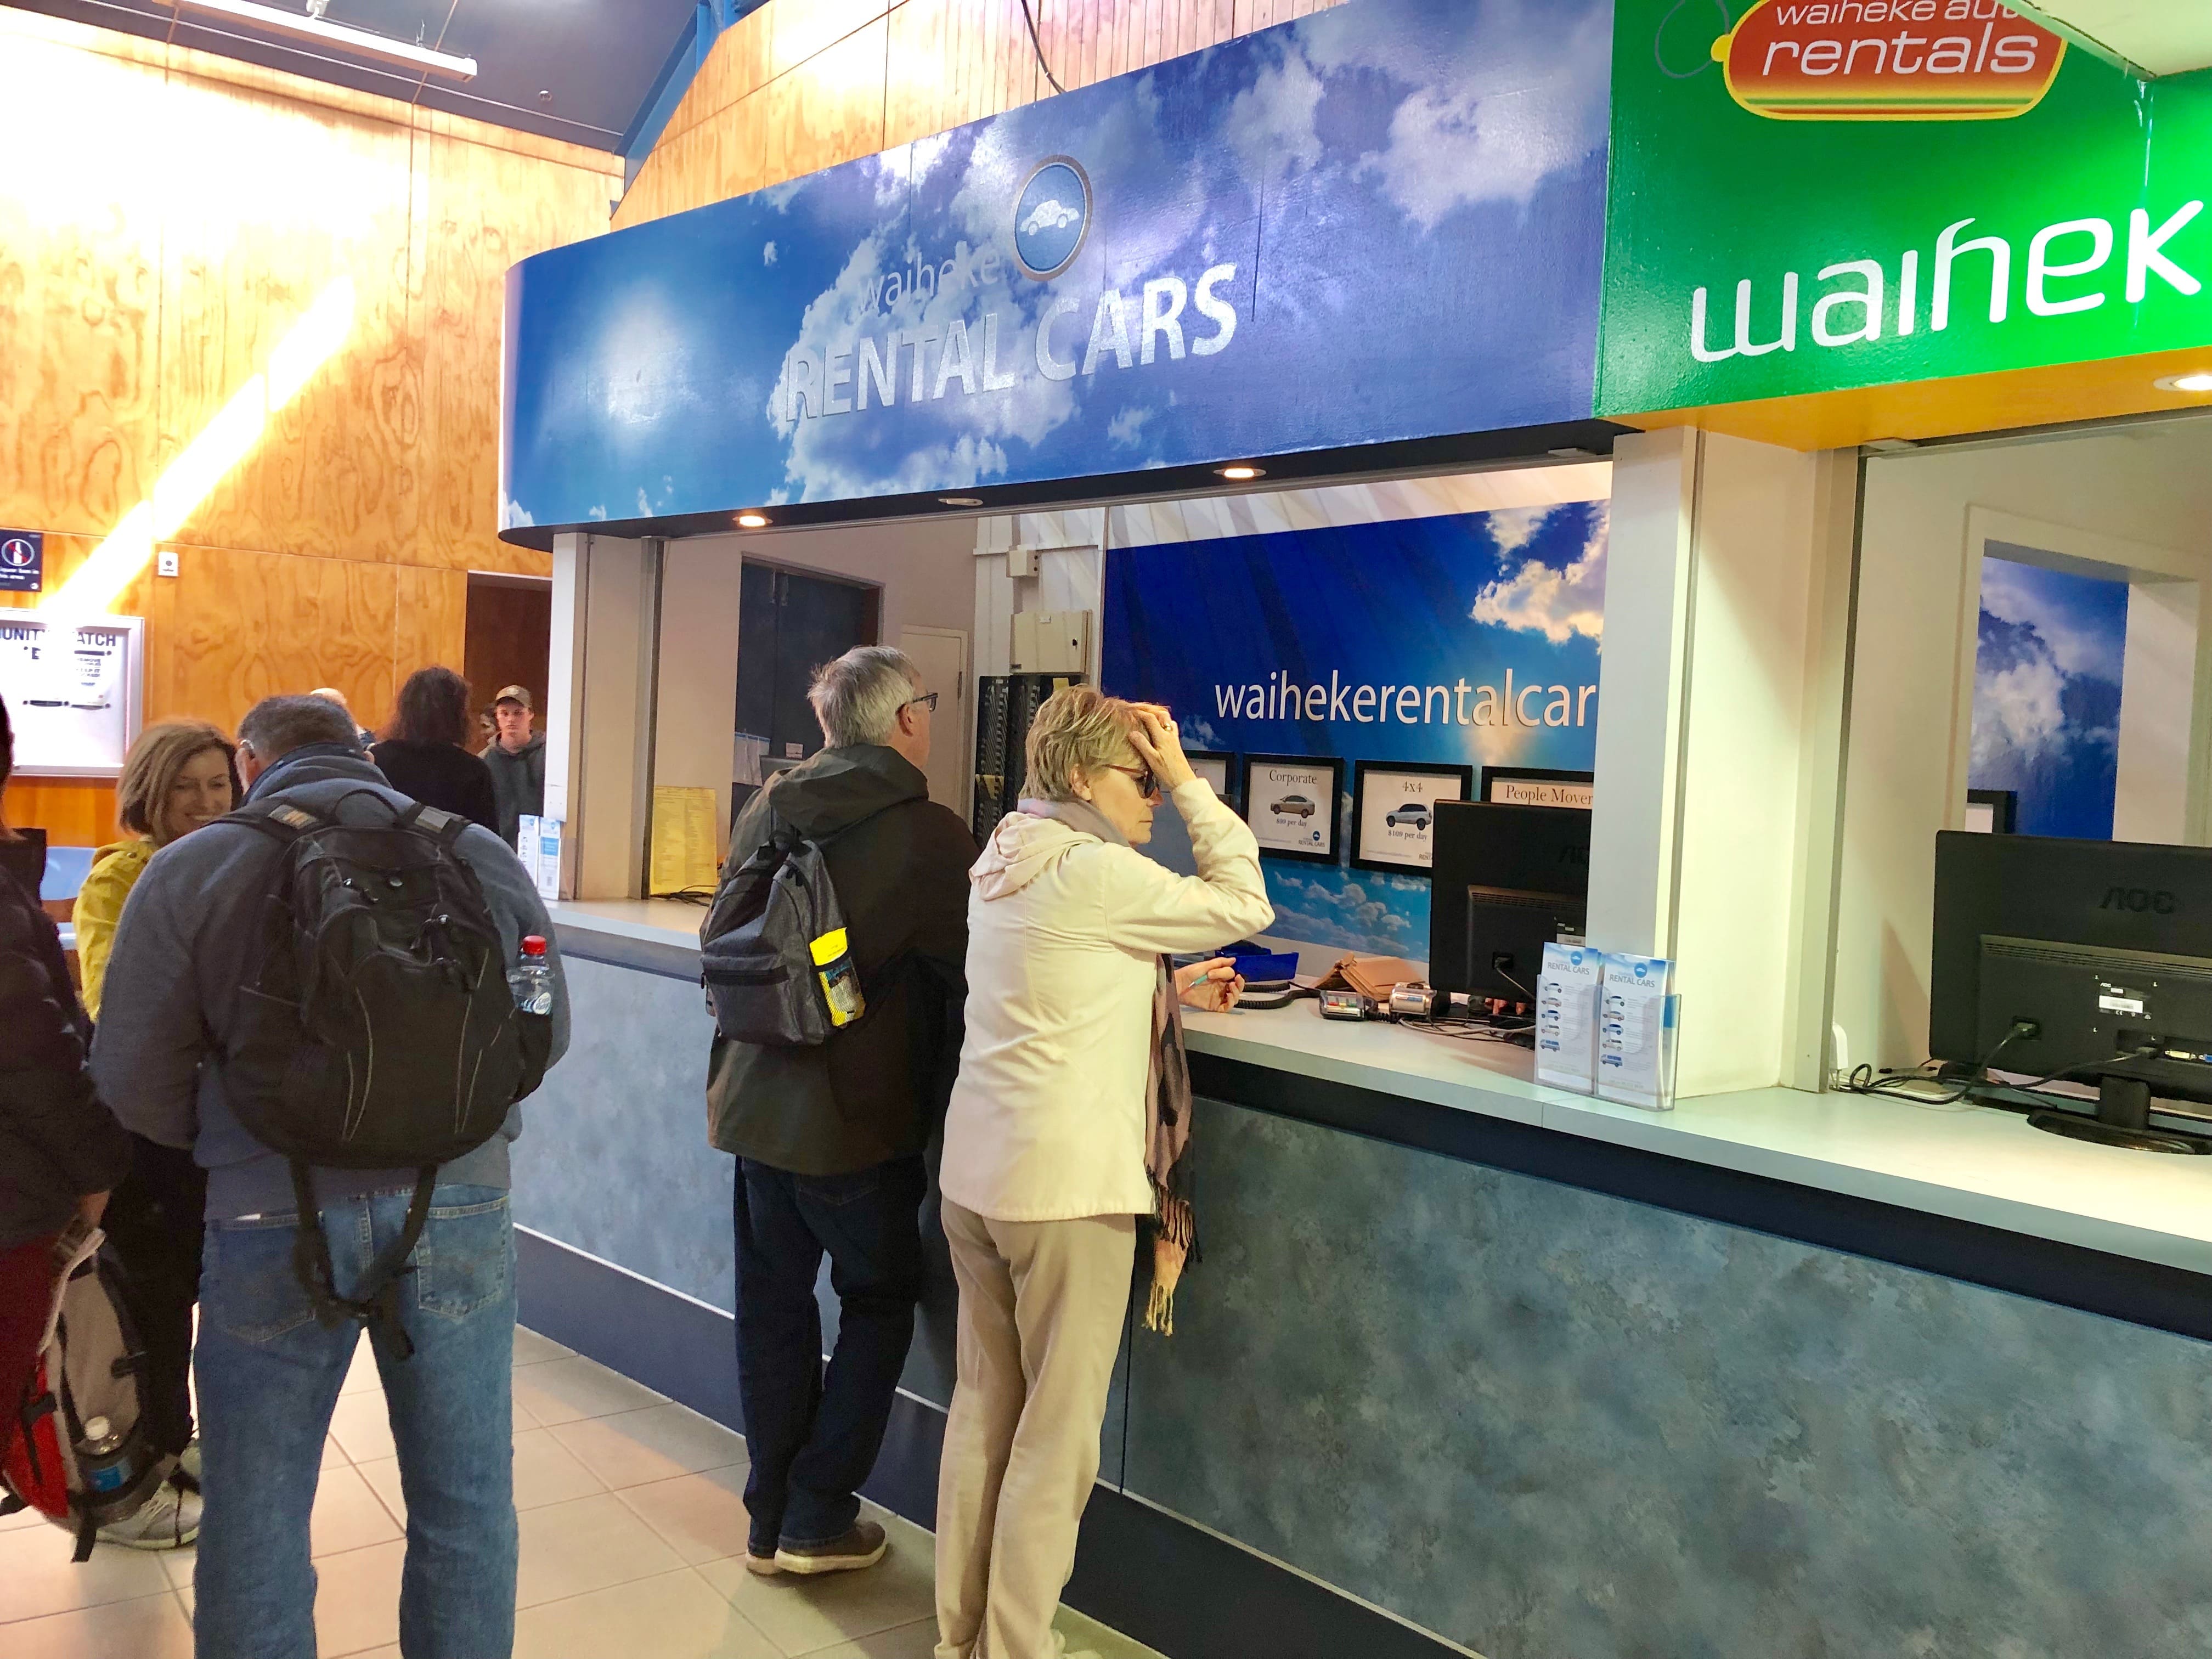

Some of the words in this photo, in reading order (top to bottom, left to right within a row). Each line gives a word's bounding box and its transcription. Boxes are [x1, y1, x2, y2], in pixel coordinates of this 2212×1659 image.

[1776, 0, 1936, 25] waiheke
[1760, 22, 2039, 76] rentals
[857, 241, 1001, 314] waiheke
[1691, 200, 2204, 362] waihek
[786, 313, 1016, 421] RENTAL
[1035, 263, 1238, 382] CARS
[1215, 669, 1596, 727] waihekerentalcar
[1269, 769, 1318, 786] Corporate
[1402, 781, 1423, 793] 4x4
[1505, 785, 1547, 805] People
[1551, 788, 1594, 805] Mover
[1297, 819, 1307, 828] day
[1417, 832, 1427, 842] day
[1547, 962, 1572, 972] RENTAL
[1572, 966, 1589, 975] CARS
[1609, 974, 1635, 985] RENTAL
[1637, 978, 1655, 988] CARS
